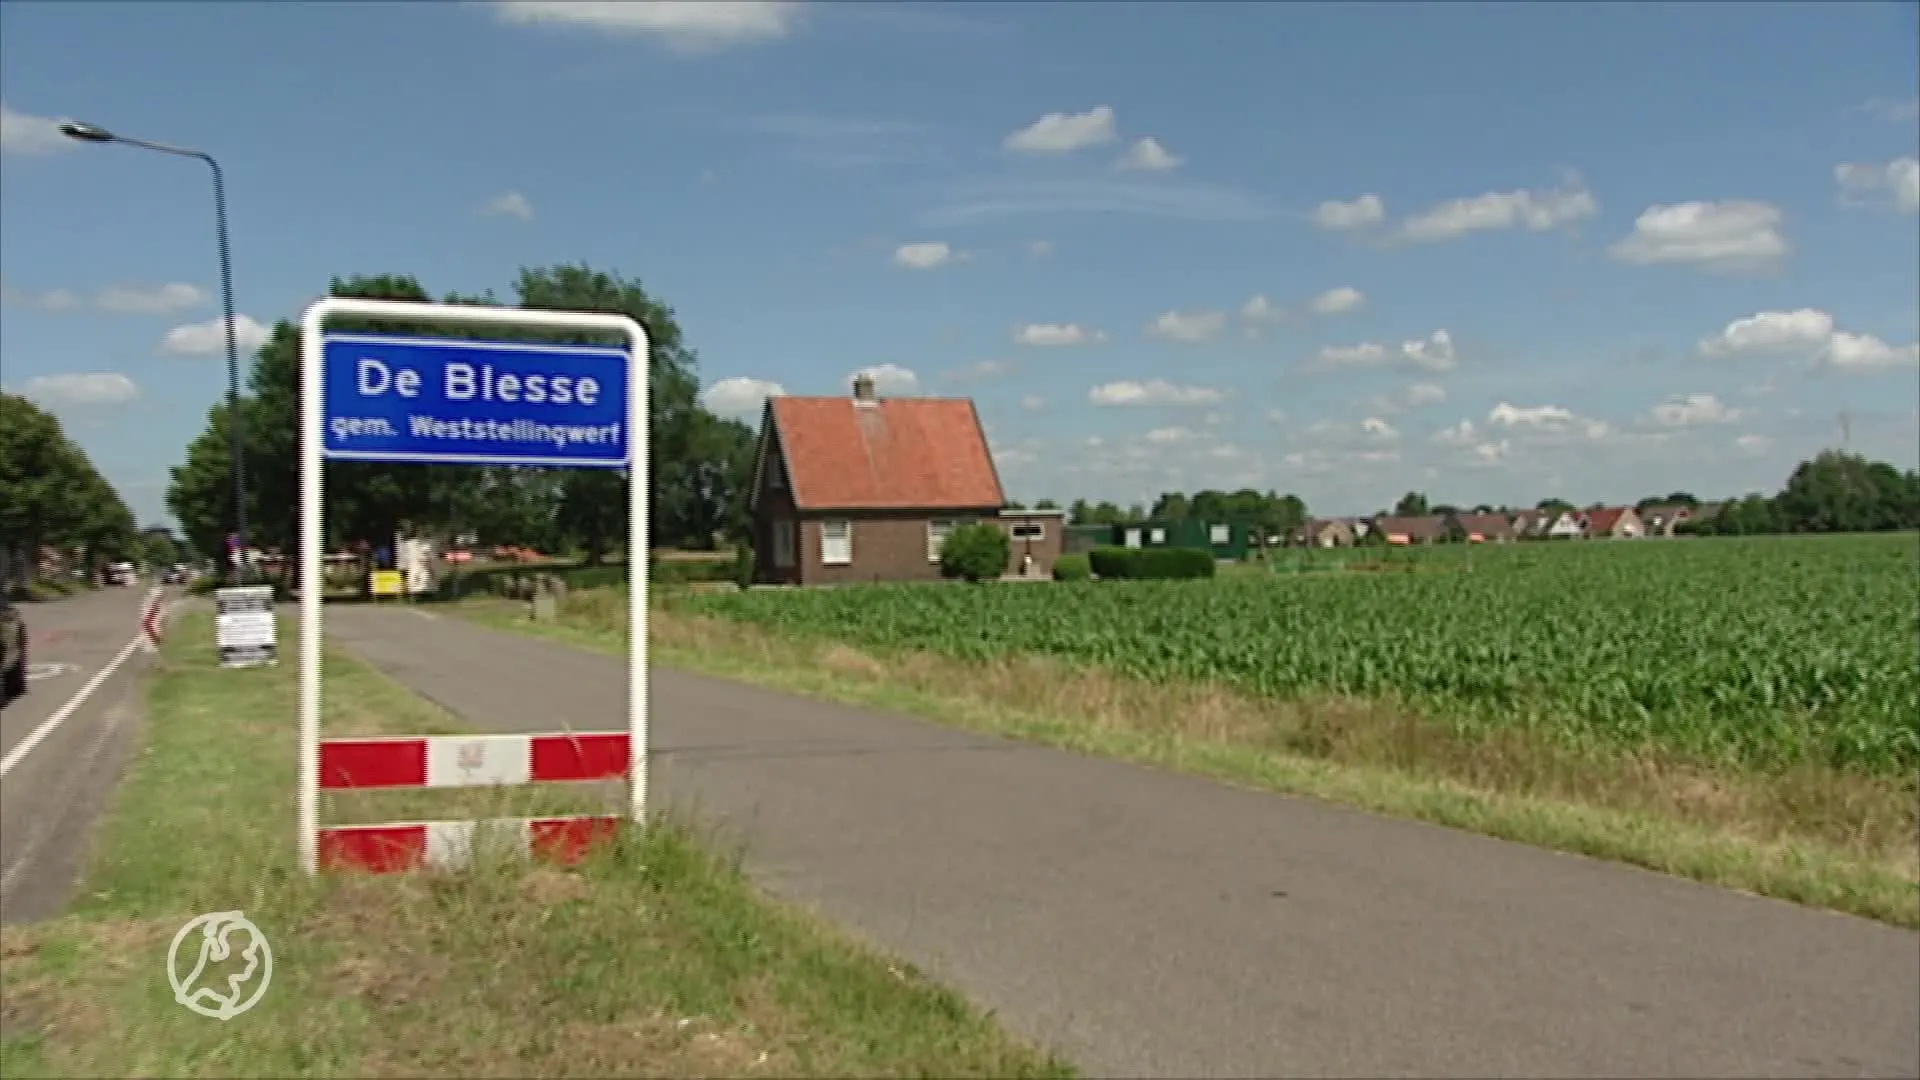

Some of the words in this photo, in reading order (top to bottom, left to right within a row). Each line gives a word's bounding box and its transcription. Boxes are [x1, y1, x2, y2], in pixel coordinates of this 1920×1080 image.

[357, 357, 422, 397] De
[444, 362, 599, 405] Blesse
[330, 415, 398, 441] gem.
[408, 415, 621, 450] Weststellingwerf
